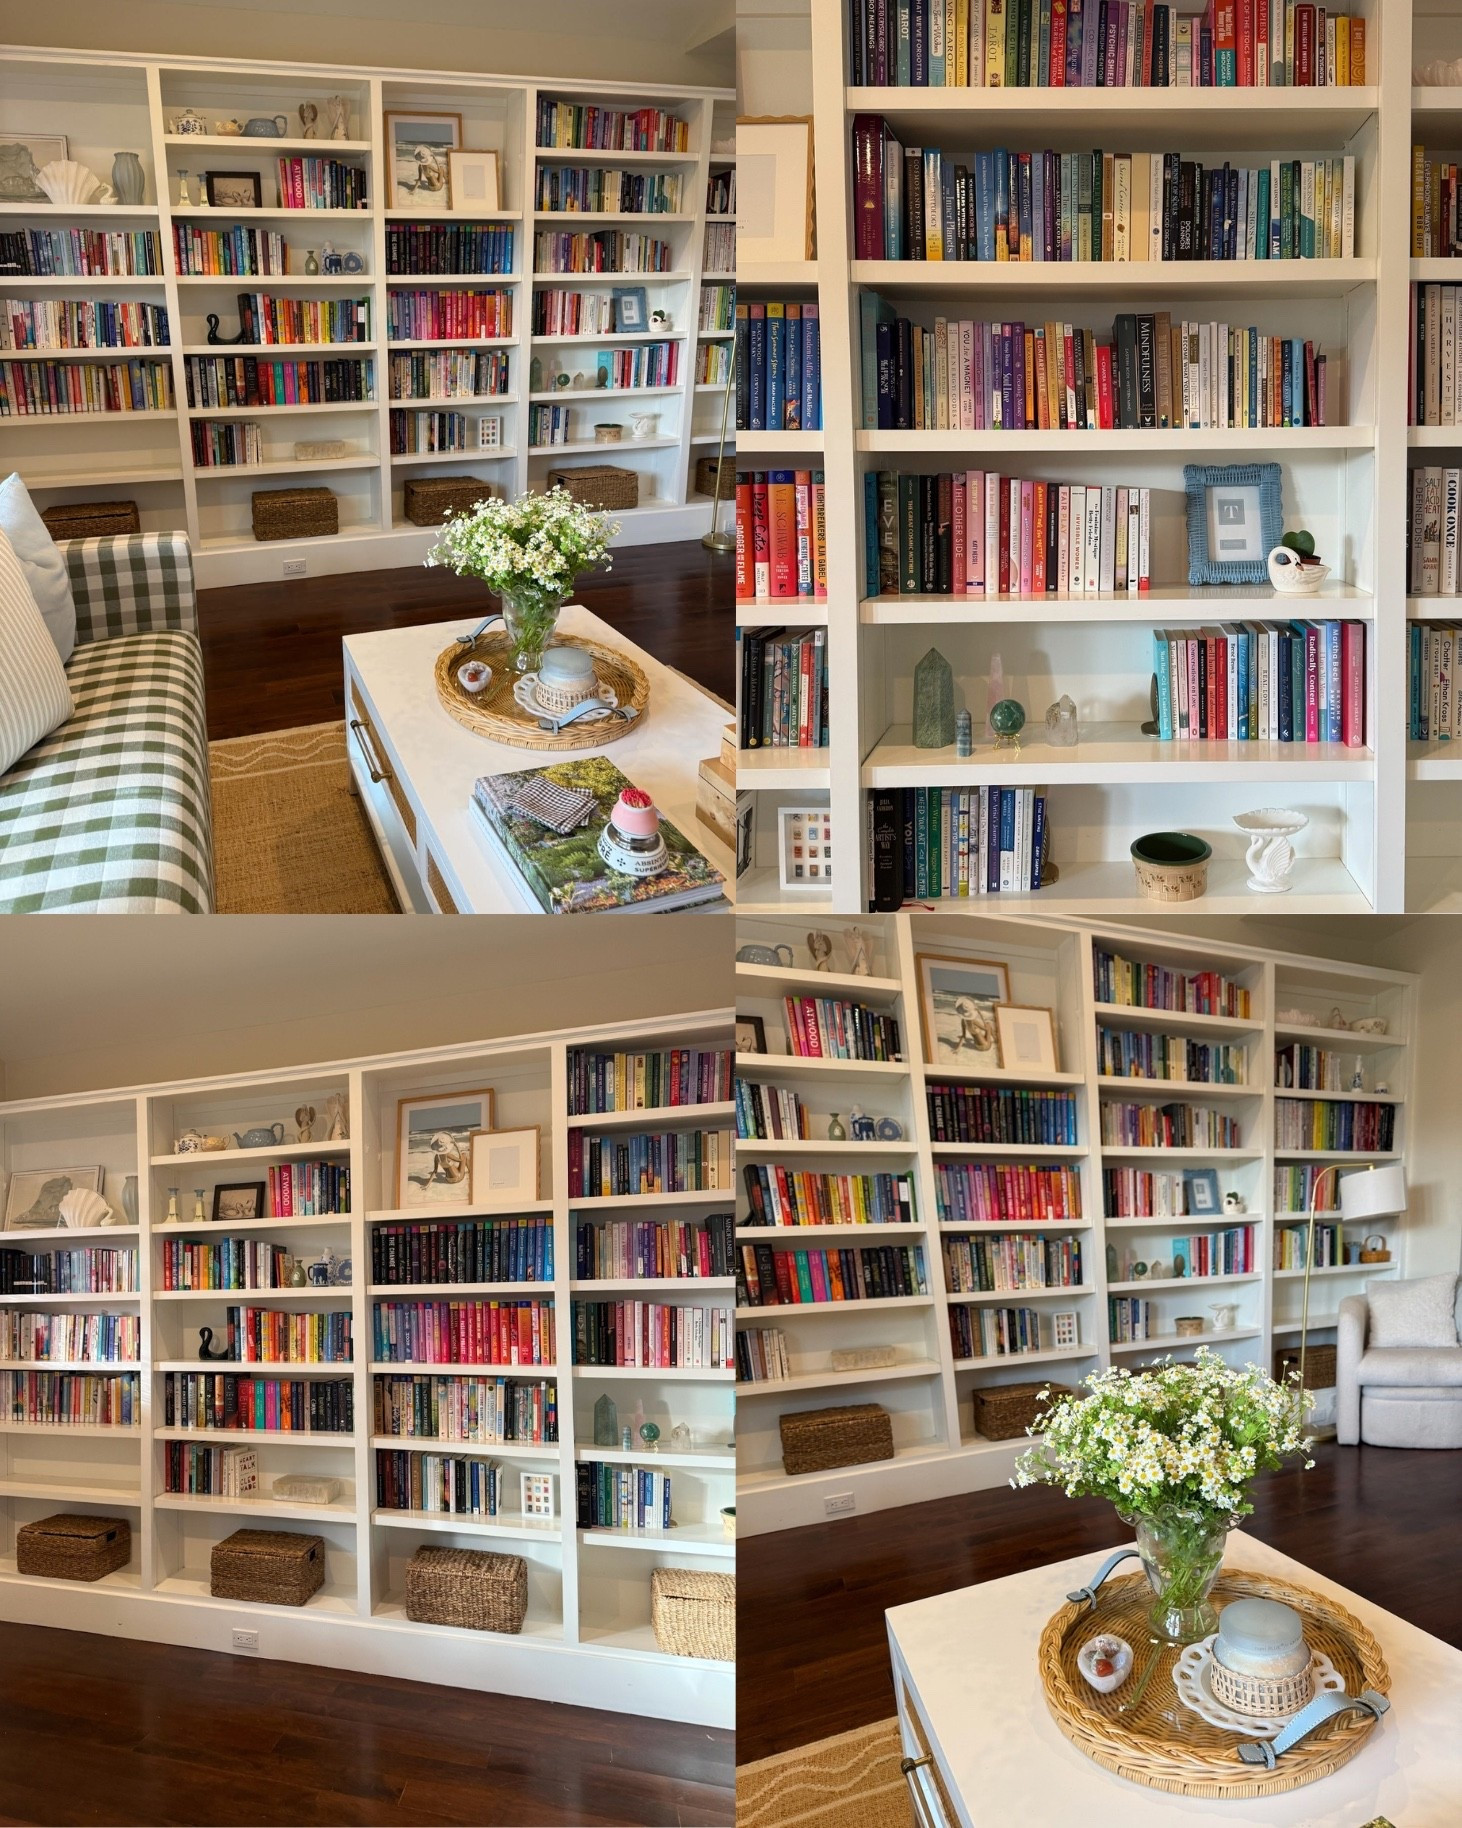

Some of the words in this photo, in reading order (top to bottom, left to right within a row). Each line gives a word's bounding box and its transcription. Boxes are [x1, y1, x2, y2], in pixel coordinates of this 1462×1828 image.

[932, 9, 942, 26] Tarot
[1244, 5, 1250, 14] OF
[901, 8, 909, 40] TAROT
[932, 26, 942, 54] Wisdom
[989, 26, 998, 62] TAROT
[1108, 24, 1116, 57] PSYCHIC
[1107, 59, 1115, 86] SHIELD
[1415, 151, 1424, 182] DREAM
[294, 165, 302, 198] ATWOOD
[1172, 186, 1179, 194] OF
[1415, 186, 1424, 201] BIG
[946, 196, 954, 219] Inner
[946, 221, 956, 253] Planets
[1273, 241, 1280, 255] AM
[806, 321, 813, 330] An
[770, 337, 778, 359] Summer
[1037, 340, 1045, 371] ECKHART
[1140, 322, 1151, 393] MINDFULNESS
[770, 359, 778, 379] Storms
[1003, 373, 1012, 386] Soul
[1003, 387, 1012, 403] Love
[1425, 478, 1440, 488] SALT
[1425, 488, 1440, 496] FAT
[753, 492, 766, 521] Deep
[1415, 487, 1423, 525] DEFINED
[1426, 496, 1440, 505] ACID
[1447, 480, 1457, 514] COOK
[816, 488, 826, 541] LIGHTBREAKERS
[1224, 505, 1239, 519] T
[1424, 505, 1440, 514] HEAT
[883, 499, 894, 545] EVE
[1446, 516, 1456, 548] ONCE
[736, 525, 745, 553] DAGGER
[755, 524, 766, 552] Cuts
[737, 562, 745, 585] FLAME
[818, 559, 826, 580] GABEL
[1434, 638, 1439, 646] AT
[1308, 636, 1316, 673] Radically
[1443, 641, 1451, 671] Chatter
[1442, 679, 1450, 701] Ethan
[1442, 702, 1450, 723] Kross
[918, 796, 926, 814] NEED
[904, 821, 912, 845] YOU
[918, 832, 926, 846] ART
[806, 1006, 818, 1048] ATWOOD
[936, 1107, 944, 1128] CHANGE
[282, 1172, 290, 1206] ATWOOD
[725, 1218, 733, 1256] MINDFULNESS
[240, 1455, 255, 1463] HEART
[240, 1461, 256, 1472] TALK
